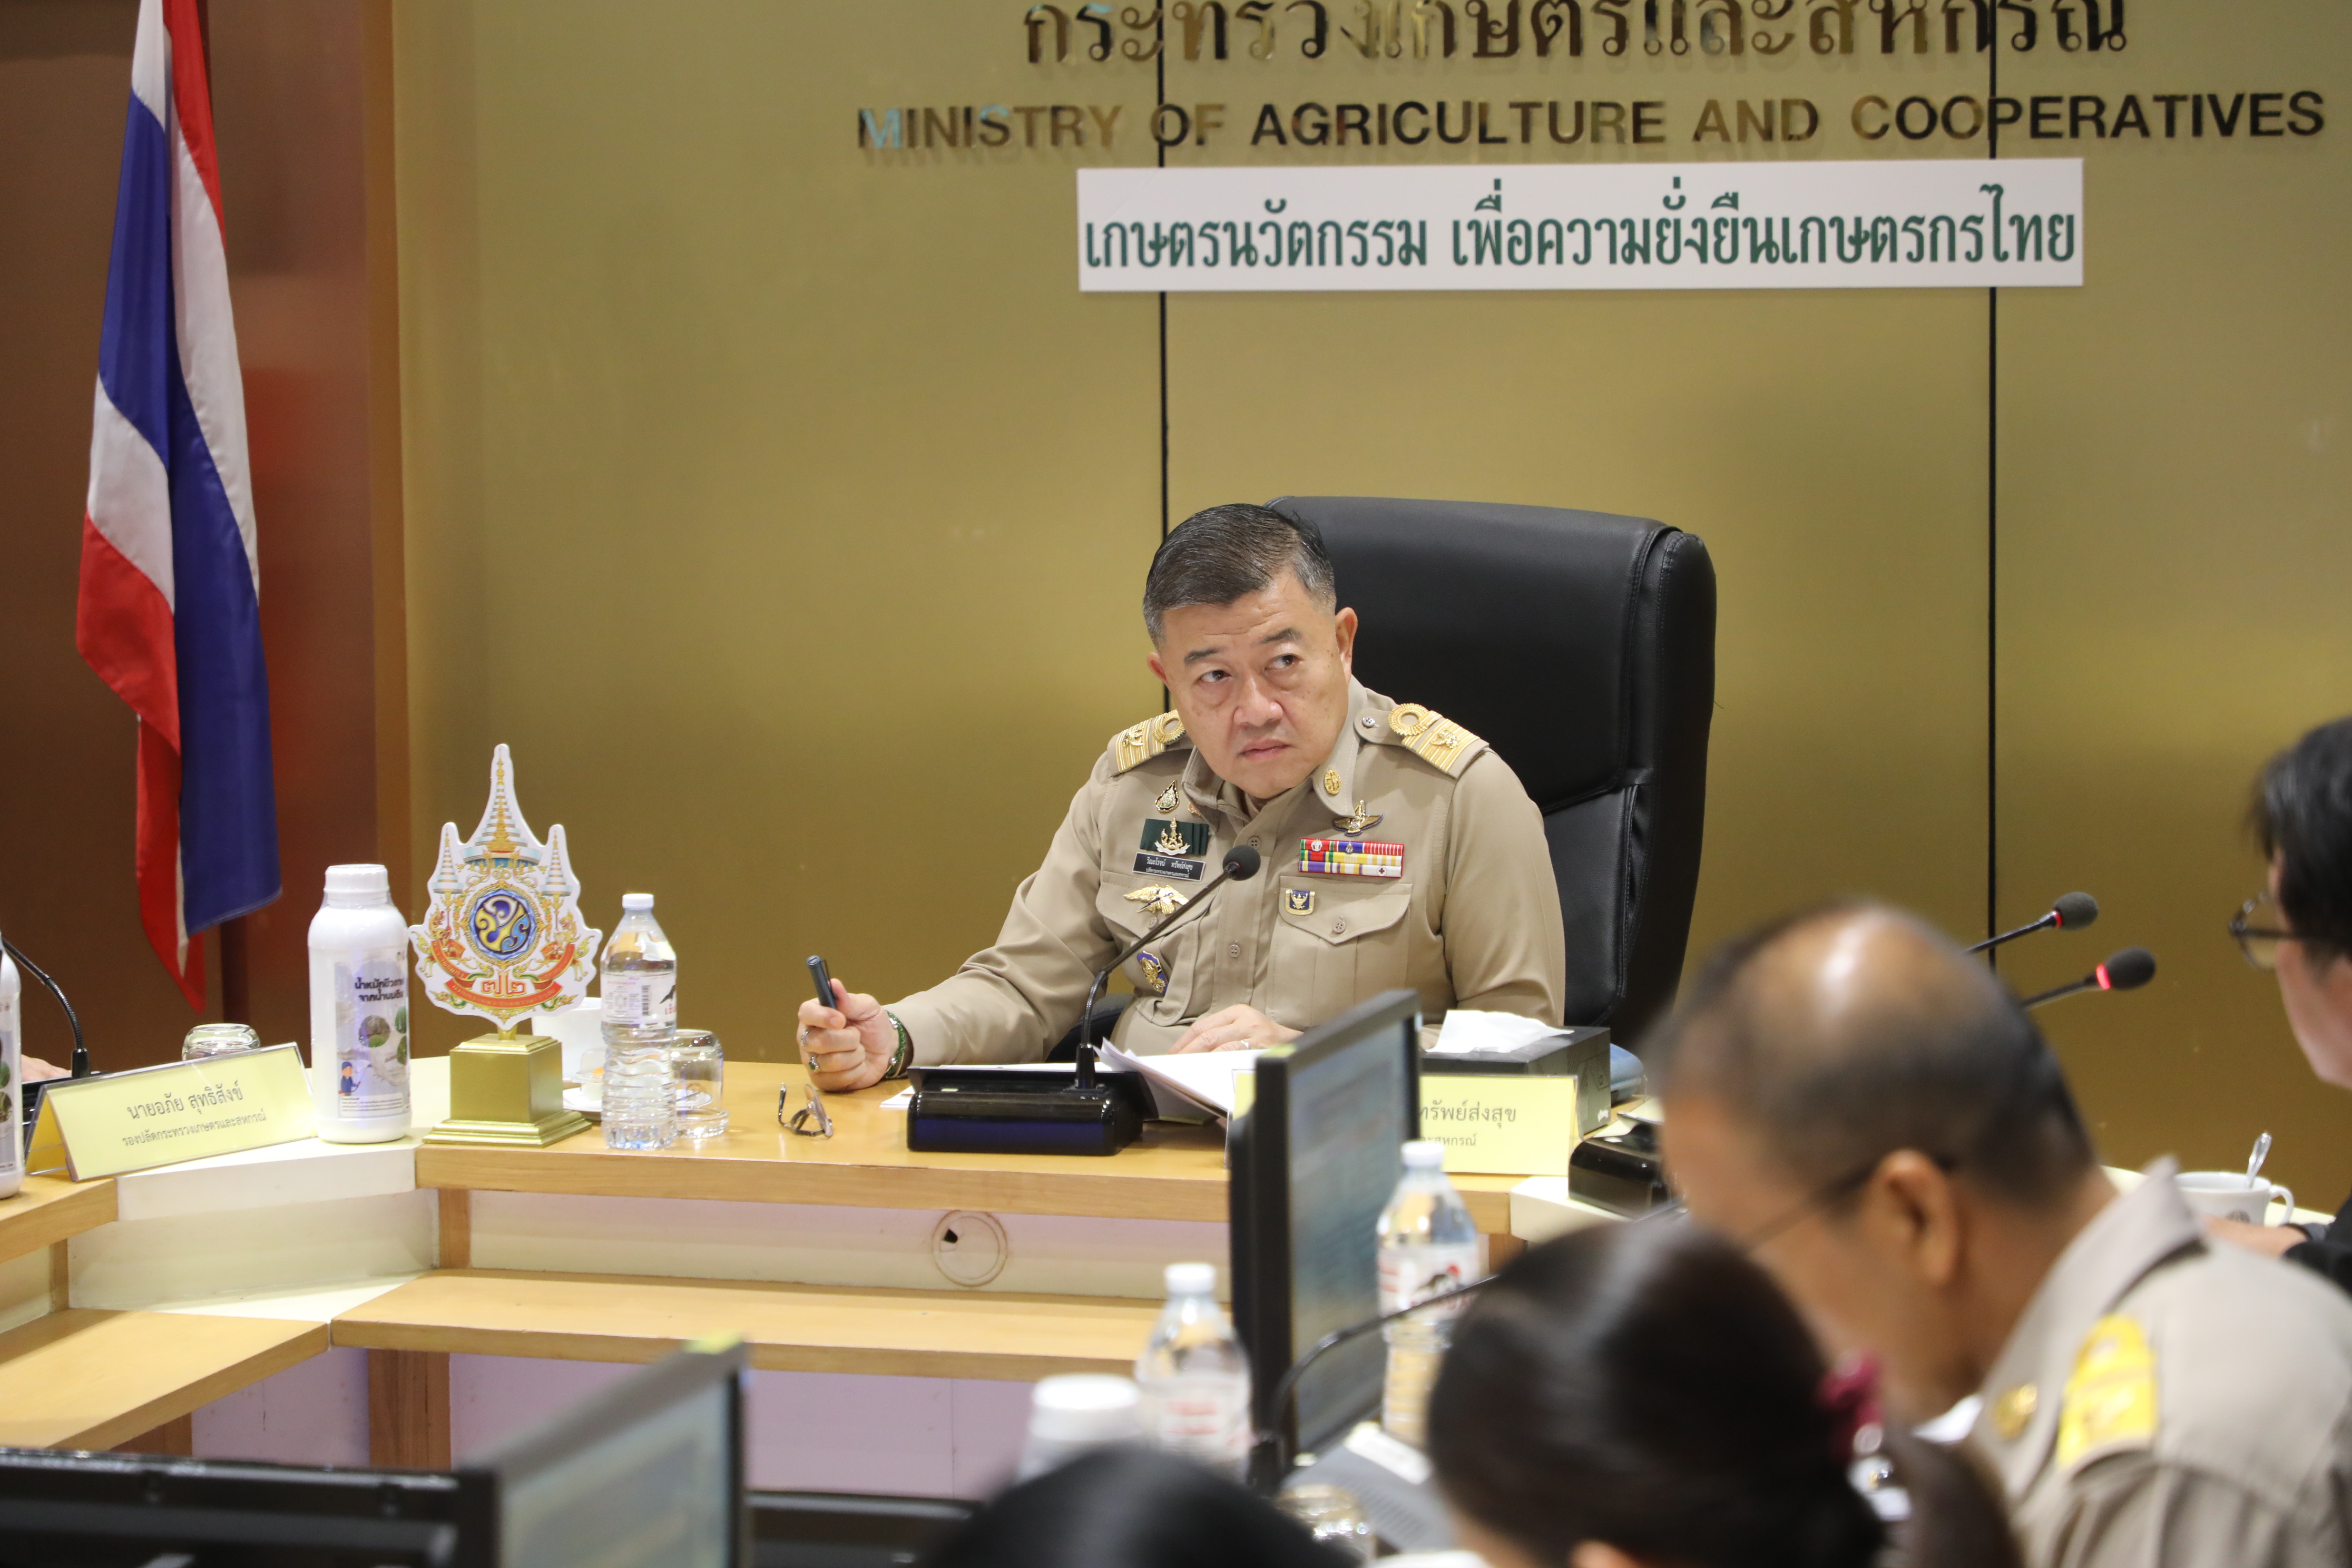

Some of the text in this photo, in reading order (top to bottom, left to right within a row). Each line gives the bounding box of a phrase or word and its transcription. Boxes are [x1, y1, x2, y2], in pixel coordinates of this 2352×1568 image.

[858, 91, 2326, 149] MINISTRY OF AGRICULTURE AND COOPERATIVES
[1085, 177, 2075, 267] เกษตรนวัตกรรม เพื่อความยั่งยืนเกษตรกรไทย
[127, 1092, 184, 1120] นายอภัย
